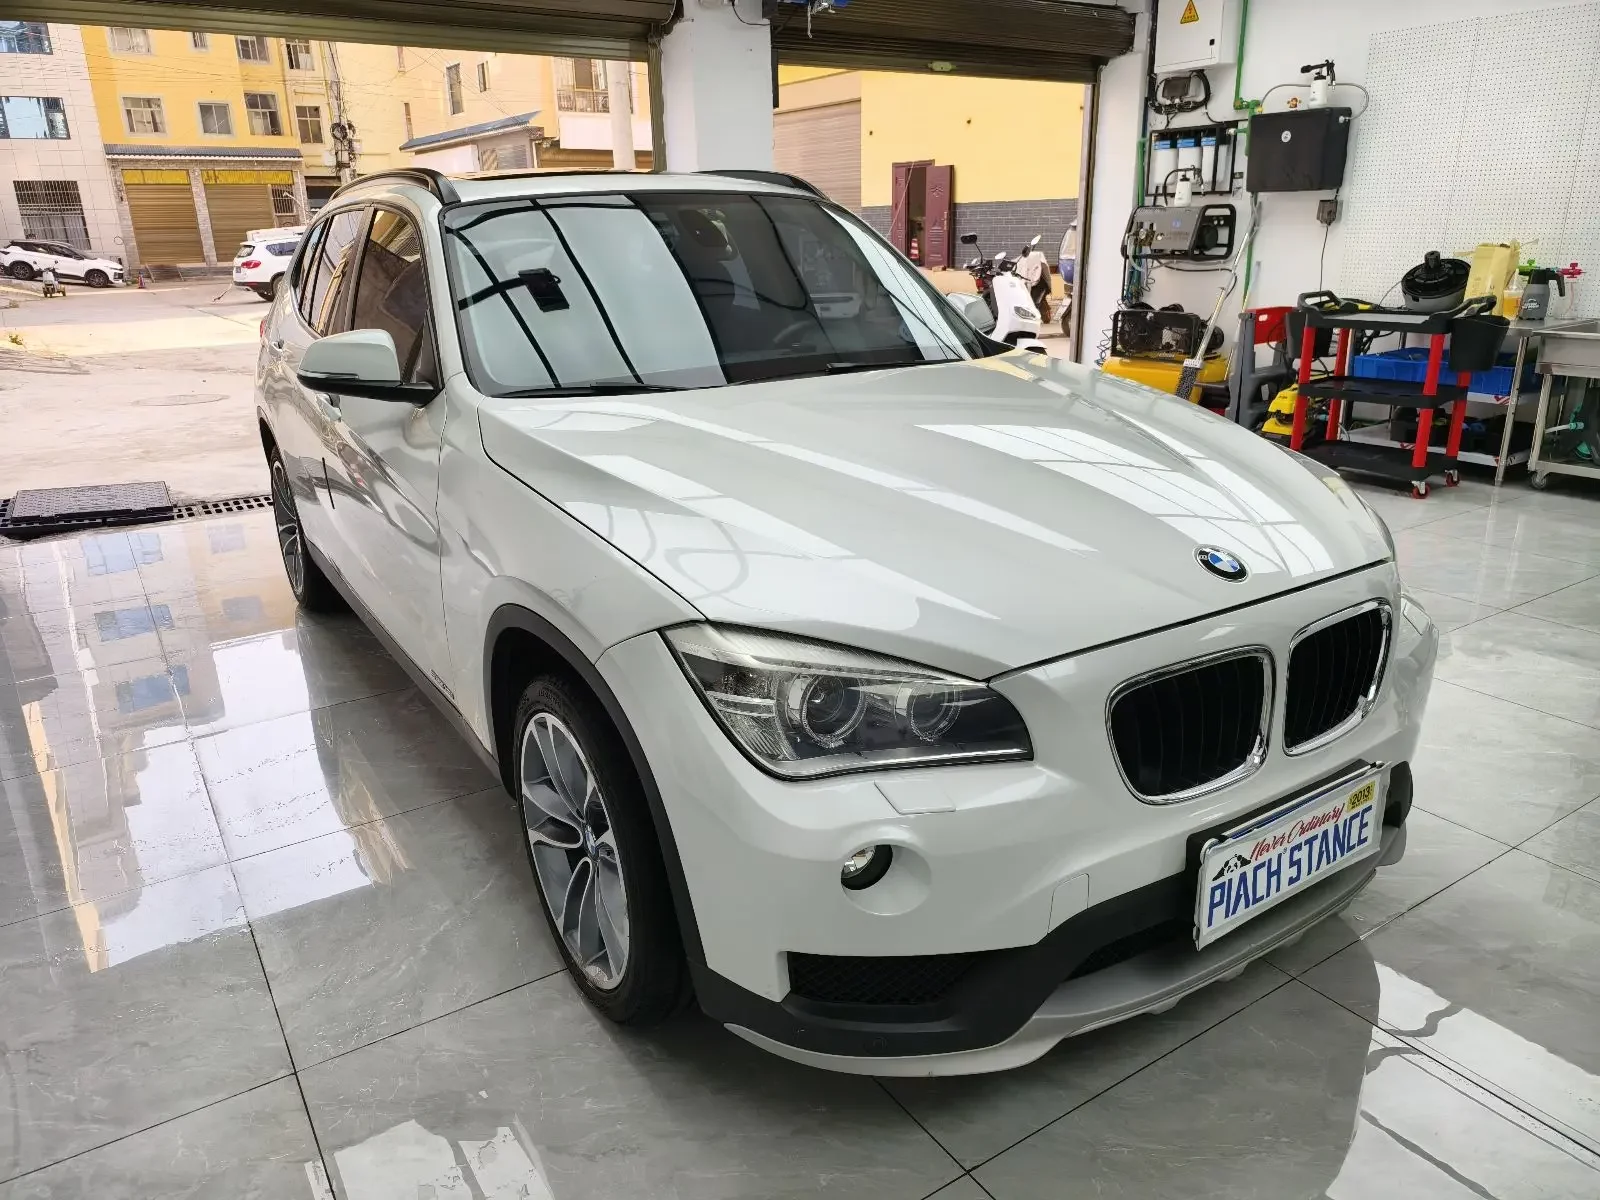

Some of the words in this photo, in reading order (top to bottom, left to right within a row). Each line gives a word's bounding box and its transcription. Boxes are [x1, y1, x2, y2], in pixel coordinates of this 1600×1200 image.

[1352, 785, 1371, 805] 2013
[1249, 832, 1286, 862] Never
[1286, 803, 1345, 844] Ordinary
[1207, 852, 1282, 928] PIACH
[1287, 805, 1373, 887] STANCE
